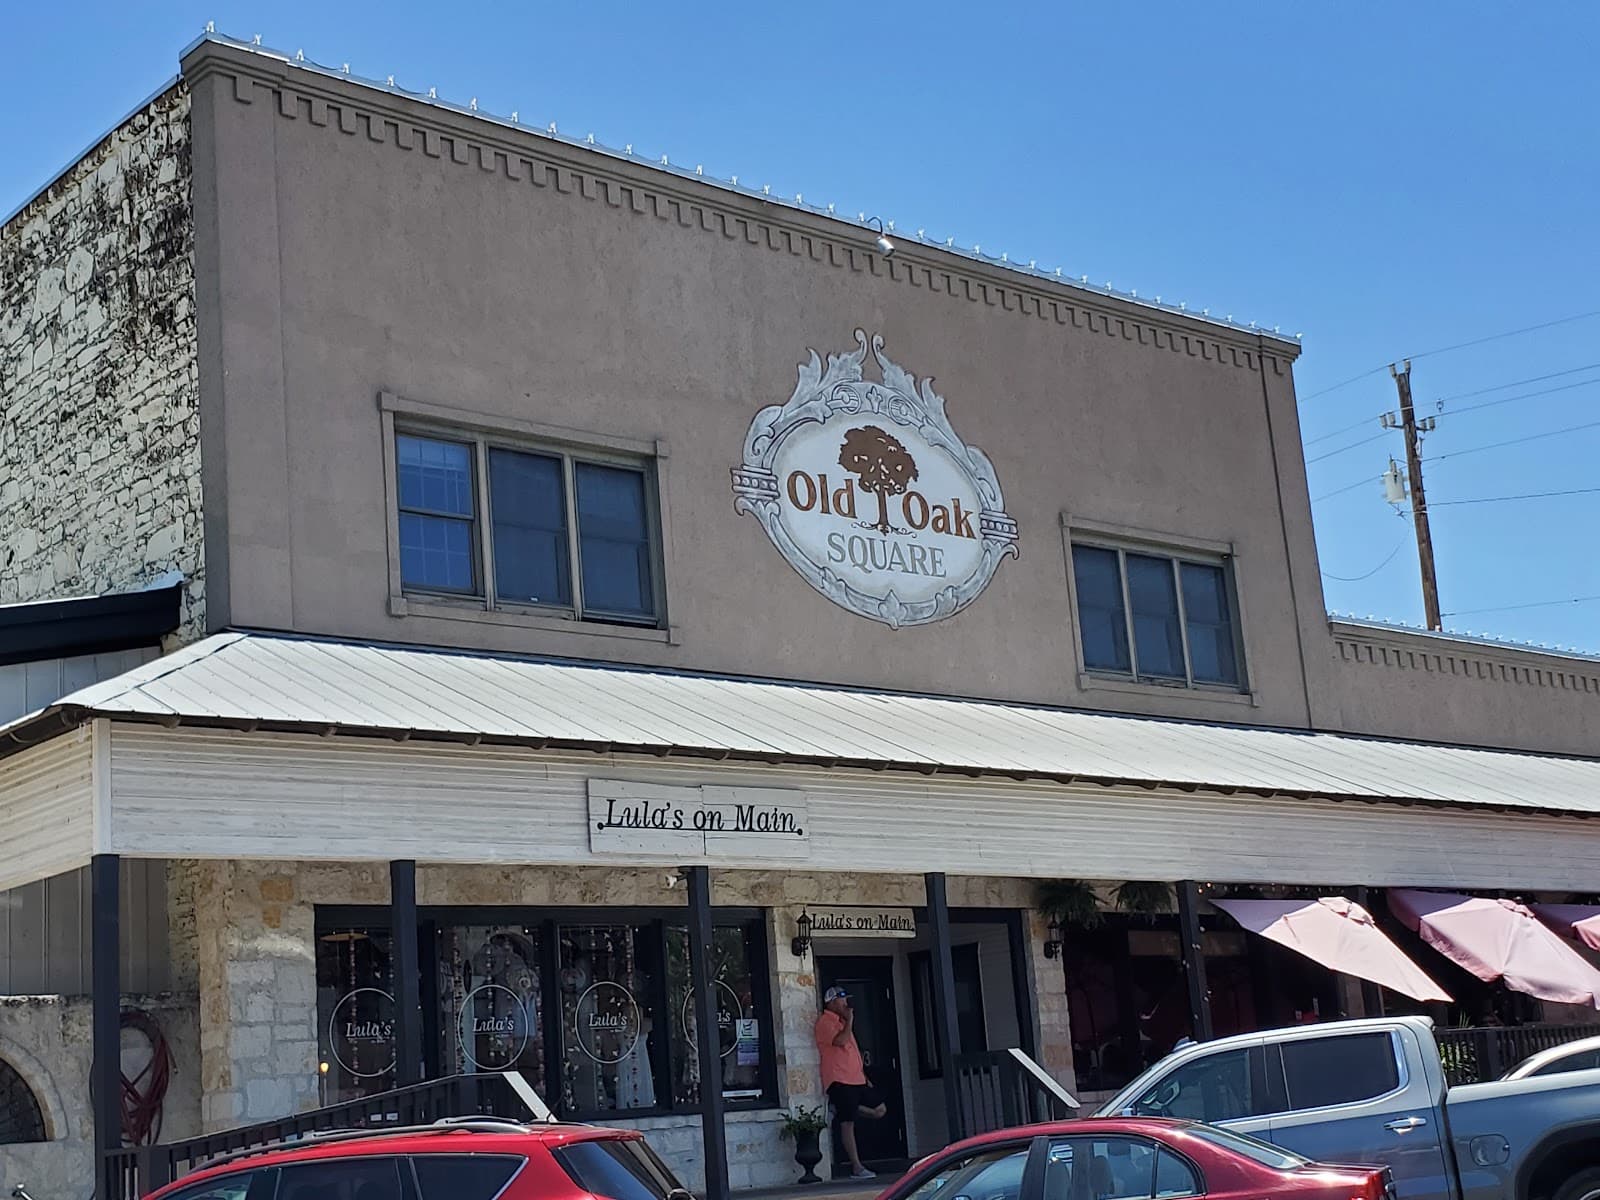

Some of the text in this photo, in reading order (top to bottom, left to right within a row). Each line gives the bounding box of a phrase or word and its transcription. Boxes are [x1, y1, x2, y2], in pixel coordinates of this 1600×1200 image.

[786, 470, 976, 539] Old Oak
[826, 531, 947, 578] SQUARE
[604, 799, 797, 833] Lula's on Main
[811, 913, 911, 931] Lula's on Main
[472, 1016, 514, 1032] Lula's
[588, 1012, 628, 1027] Lula's
[346, 1021, 392, 1037] Lula's
